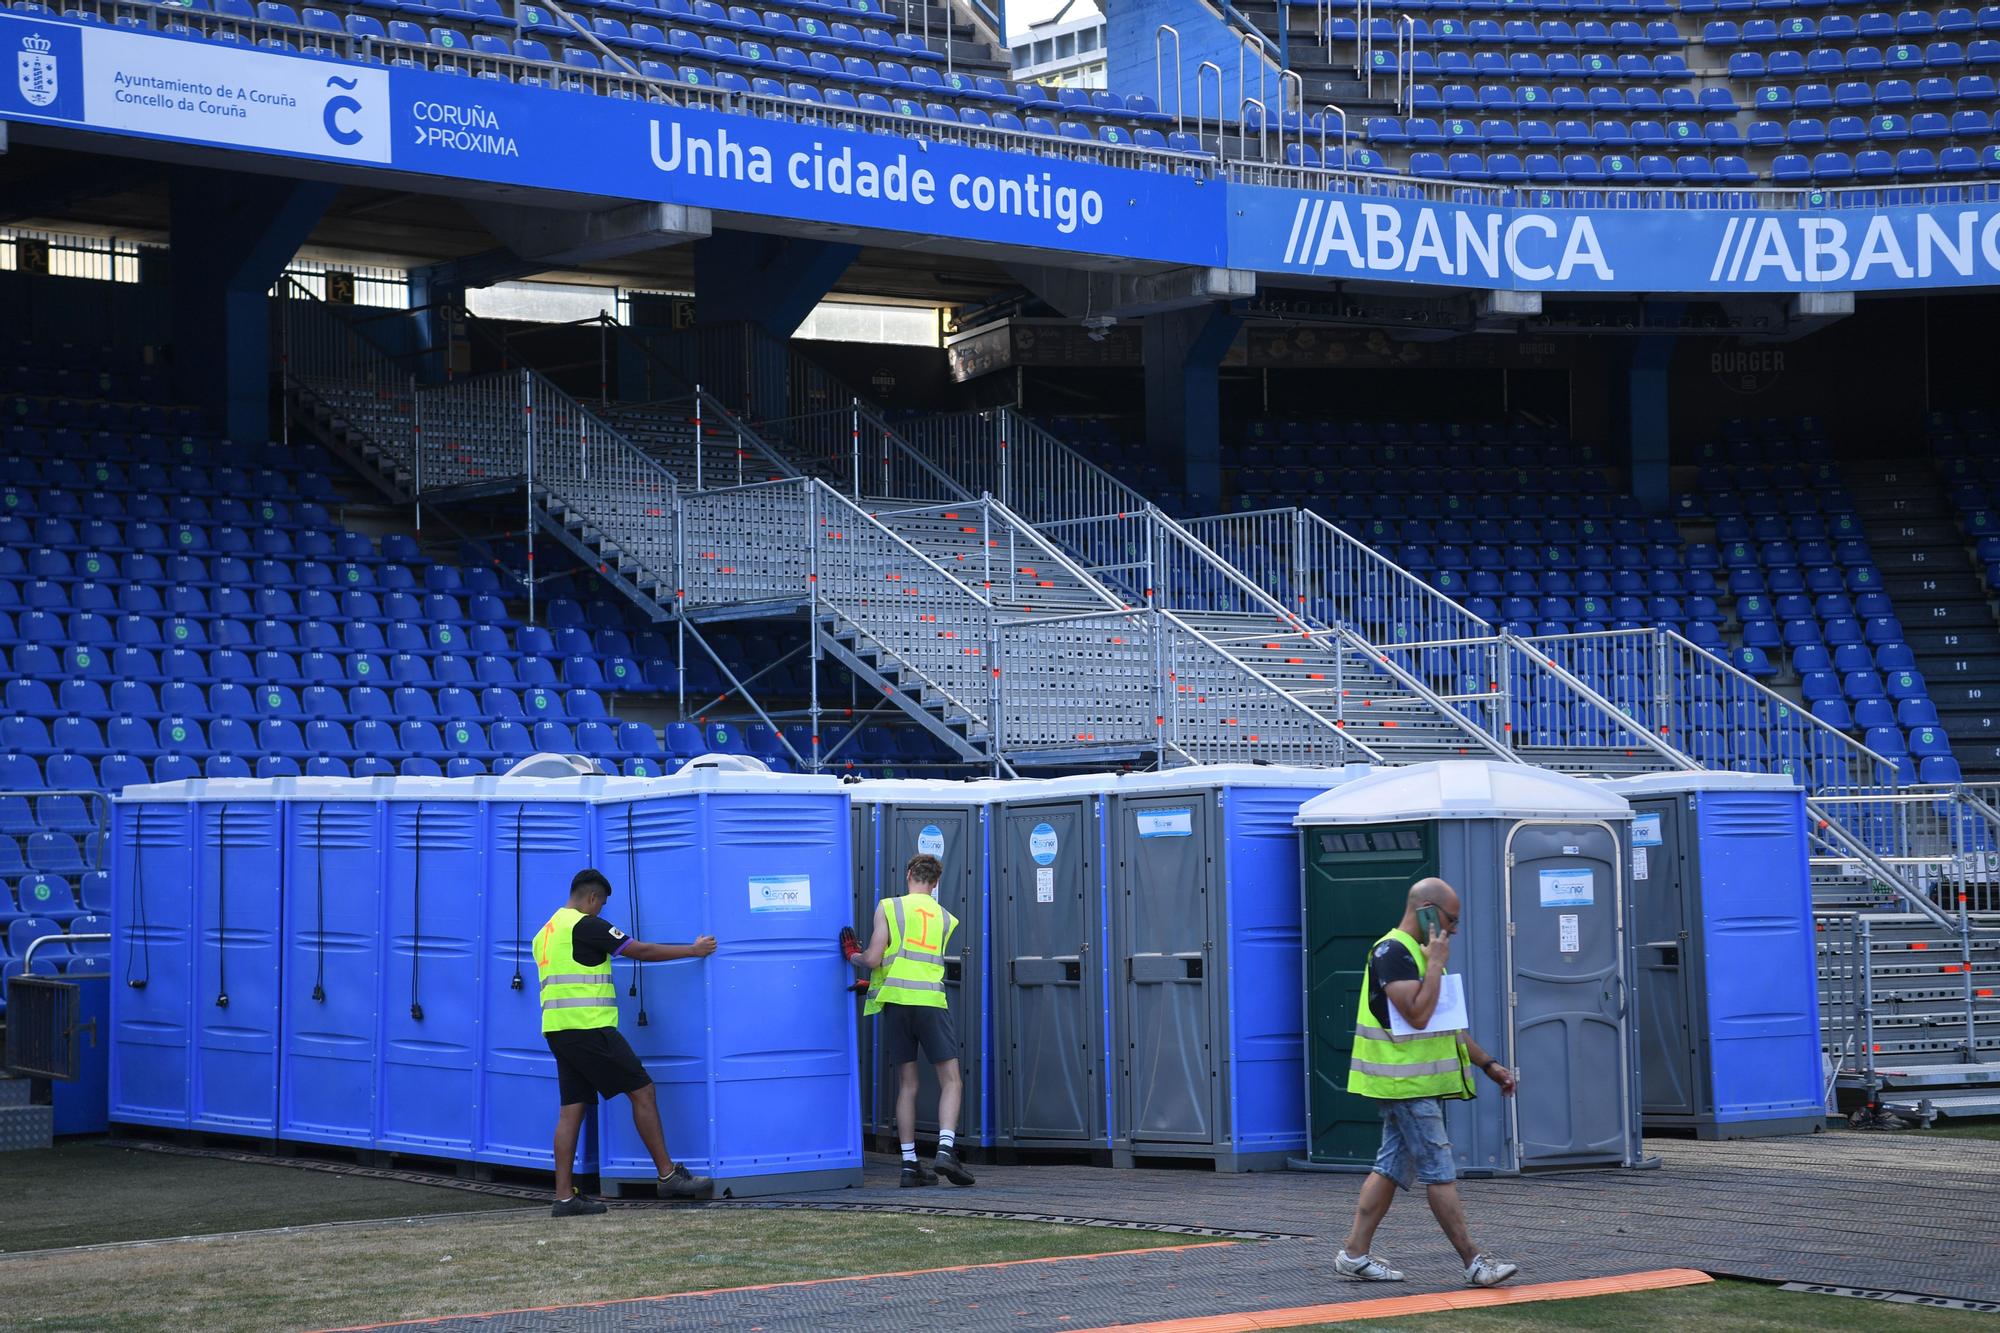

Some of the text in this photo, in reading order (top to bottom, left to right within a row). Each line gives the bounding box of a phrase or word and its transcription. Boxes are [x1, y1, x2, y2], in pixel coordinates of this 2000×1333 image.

[114, 71, 297, 107] Ayuntamiento de A Coruña
[114, 89, 247, 118] Concello da Coruña
[412, 101, 500, 130] CORUÑA
[429, 127, 519, 157] PRÓXIMA
[649, 119, 1104, 234] Unha cidade contigo
[1711, 350, 1785, 374] BURGER
[1893, 500, 1906, 509] 17
[1901, 527, 1915, 536] 16
[1911, 553, 1925, 562] 15
[1922, 580, 1937, 590] 14
[1944, 635, 1958, 645] 12
[1955, 661, 1968, 671] 11
[1968, 689, 1982, 699] 10
